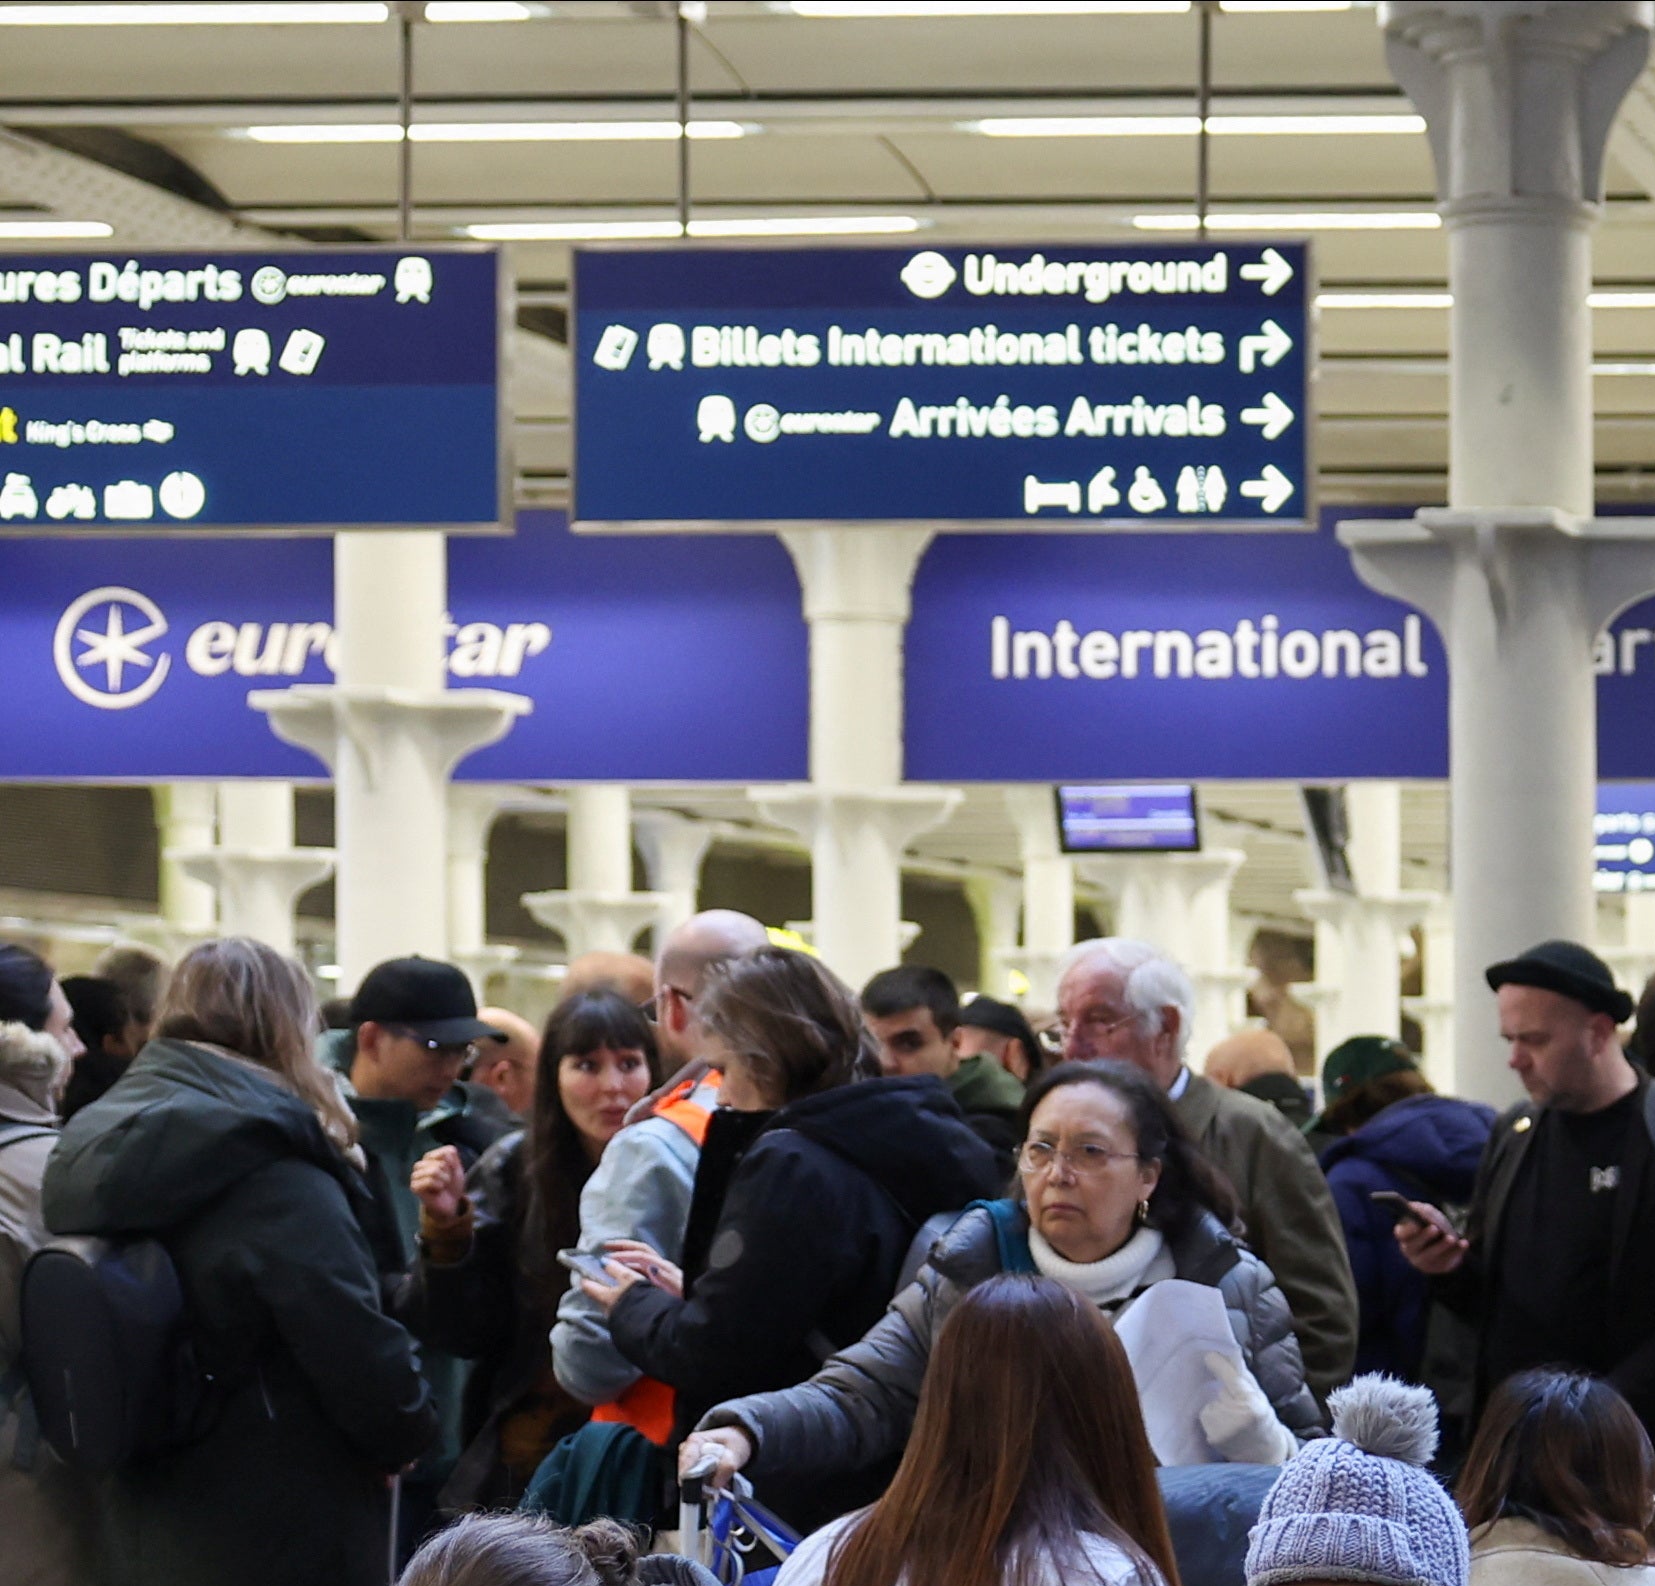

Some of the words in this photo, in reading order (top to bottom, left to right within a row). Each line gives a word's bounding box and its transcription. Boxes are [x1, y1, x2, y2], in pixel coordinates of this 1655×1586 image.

[89, 259, 243, 311] Départs
[964, 252, 1228, 303] Underground
[32, 333, 111, 374] Rail
[691, 324, 821, 367] Billets
[828, 324, 1083, 367] International
[1089, 323, 1226, 367] tickets
[889, 394, 1060, 438] Arrivées
[1064, 394, 1226, 438] Arrivals
[991, 613, 1428, 681] International
